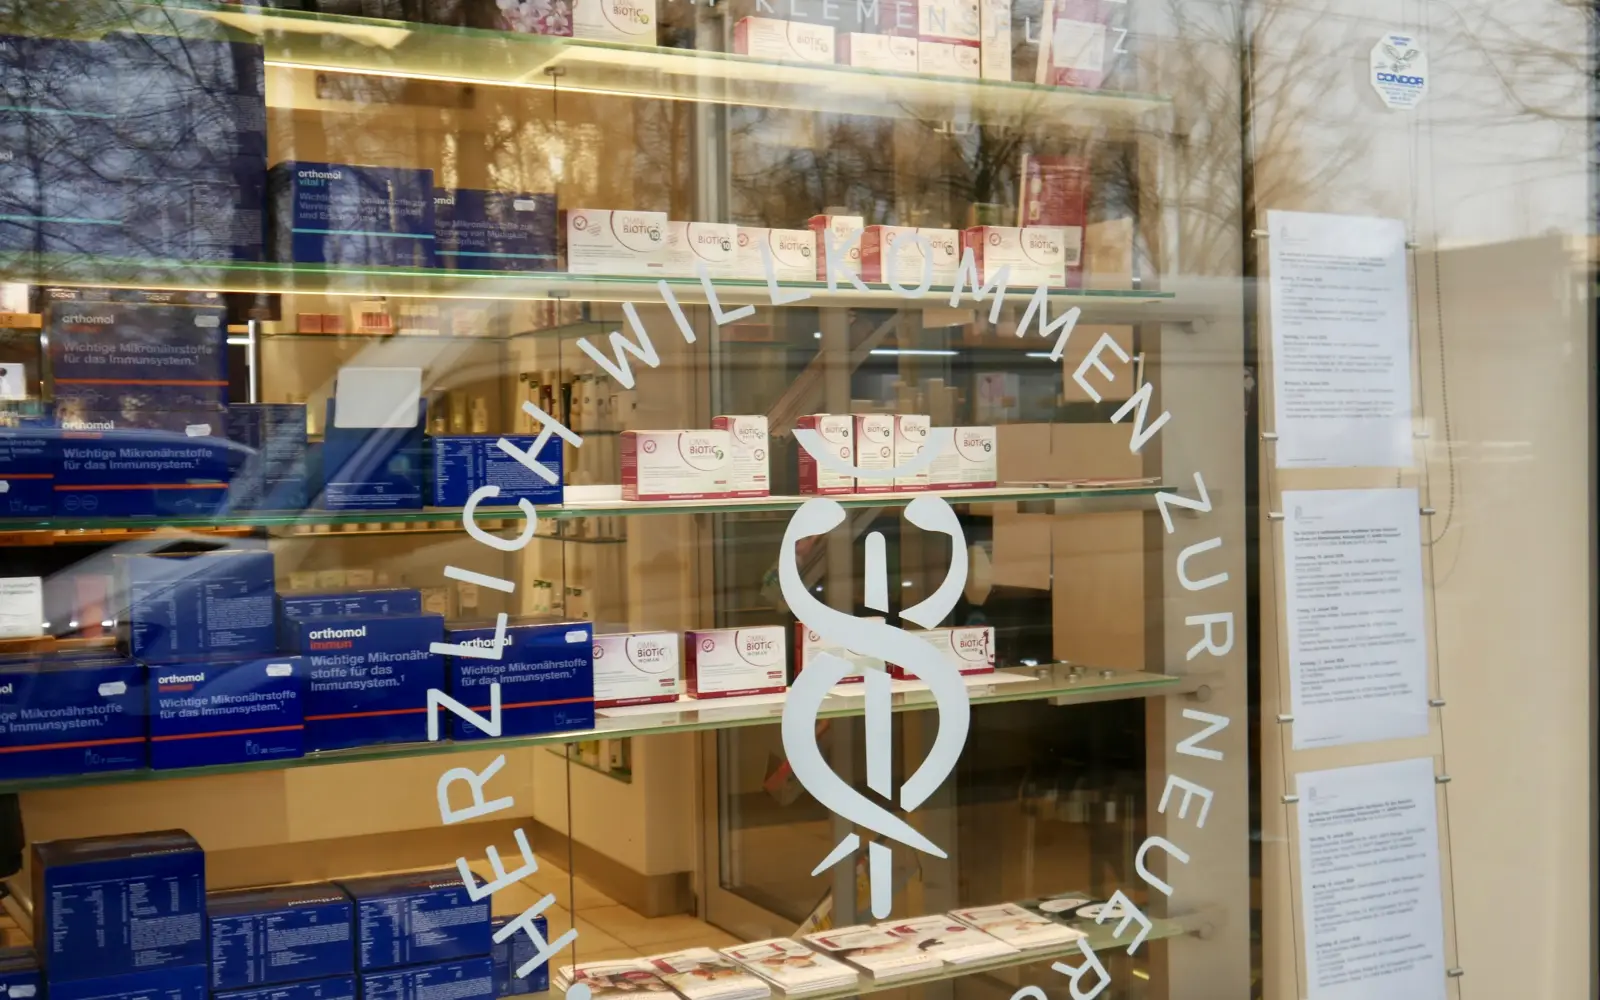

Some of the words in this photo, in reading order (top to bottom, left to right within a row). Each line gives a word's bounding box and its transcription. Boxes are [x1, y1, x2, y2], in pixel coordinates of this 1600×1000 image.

[1376, 72, 1425, 85] CONDOR
[298, 169, 342, 180] orthomol
[62, 314, 114, 325] orthomol
[575, 226, 1172, 455] WILLKOMMEN
[84, 354, 106, 364] das
[63, 448, 116, 459] Wichtige
[120, 448, 213, 459] Mikronährstoffe
[64, 460, 81, 470] für
[84, 460, 107, 470] das
[1154, 471, 1235, 661] ZUR
[309, 625, 366, 639] orthomol
[310, 655, 365, 667] Wichtige
[368, 650, 434, 663] Mikronähr-
[311, 668, 347, 679] stoffe
[350, 666, 368, 677] für
[370, 665, 393, 675] das
[461, 664, 506, 676] Wichtige
[508, 658, 588, 672] Mikronährstoffe
[158, 672, 205, 684] orthomol
[461, 677, 476, 686] für
[479, 675, 498, 684] das
[426, 400, 584, 979] HERZLICH
[159, 697, 208, 709] Wichtige
[211, 690, 297, 704] Mikronährstoffe
[21, 703, 123, 720] Mikronährstoffe
[160, 709, 175, 719] für
[179, 707, 199, 718] das
[1008, 708, 1231, 1000] NEUER
